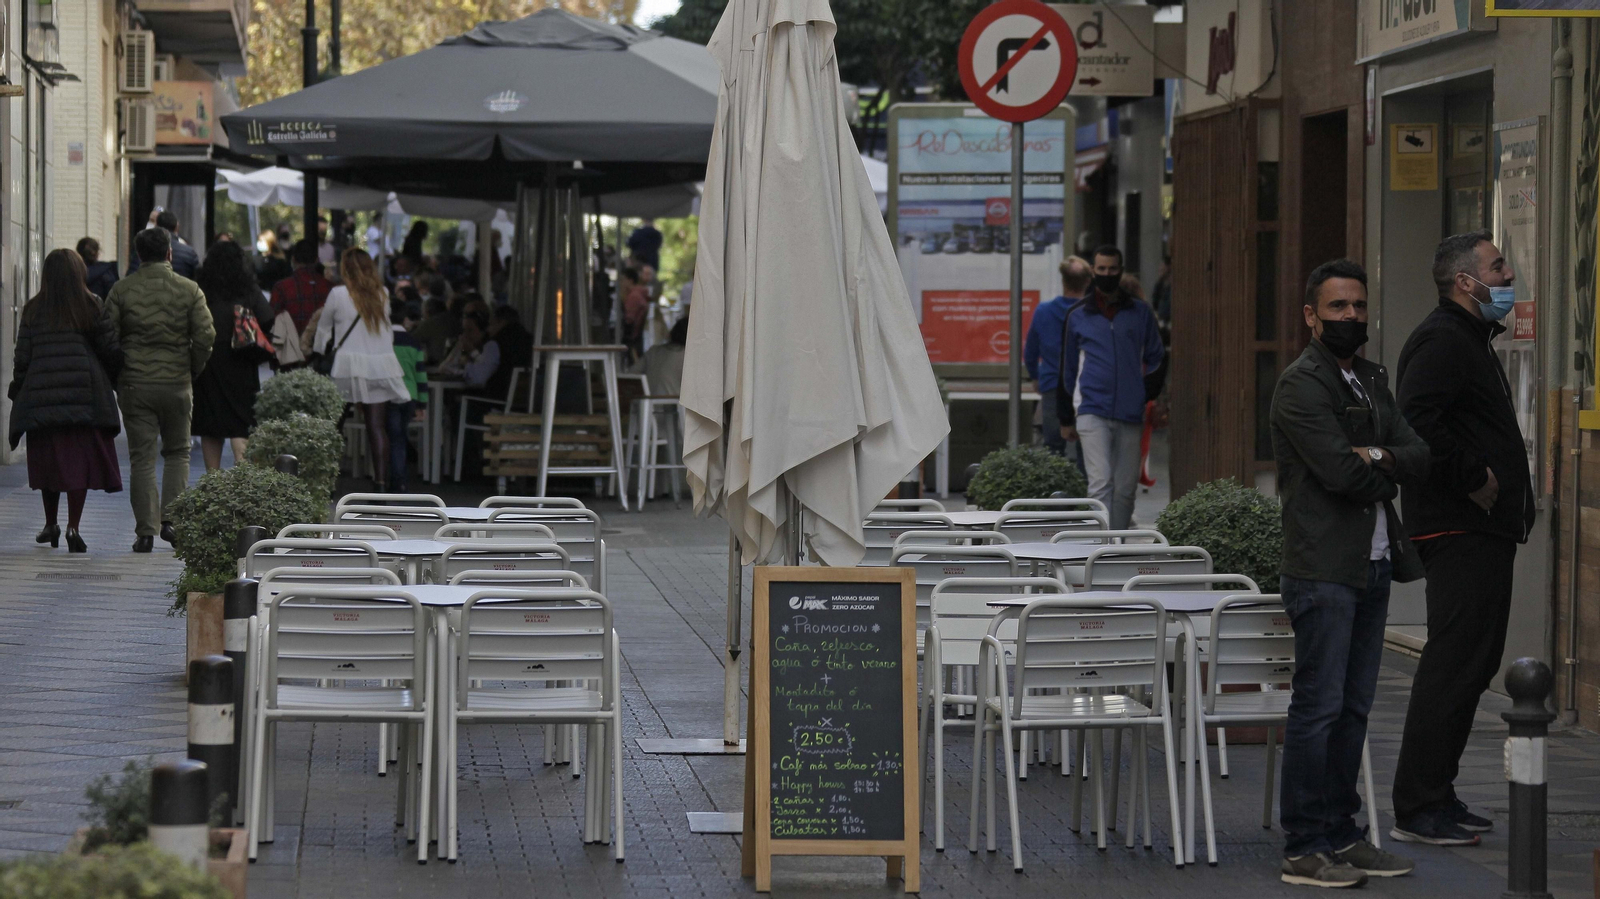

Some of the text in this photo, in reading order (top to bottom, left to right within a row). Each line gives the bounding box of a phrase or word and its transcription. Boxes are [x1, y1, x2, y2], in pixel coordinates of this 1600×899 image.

[1078, 52, 1131, 64] cantador
[280, 122, 322, 131] BODEGA
[267, 130, 327, 140] Estrella Galicia
[902, 174, 937, 183] Nuevas
[1023, 174, 1061, 185] lgeciras
[792, 615, 868, 634] PROMOCION
[772, 658, 802, 675] agua
[826, 654, 855, 670] tinto
[861, 660, 897, 670] verano
[826, 700, 843, 711] del
[780, 777, 814, 794] Happy
